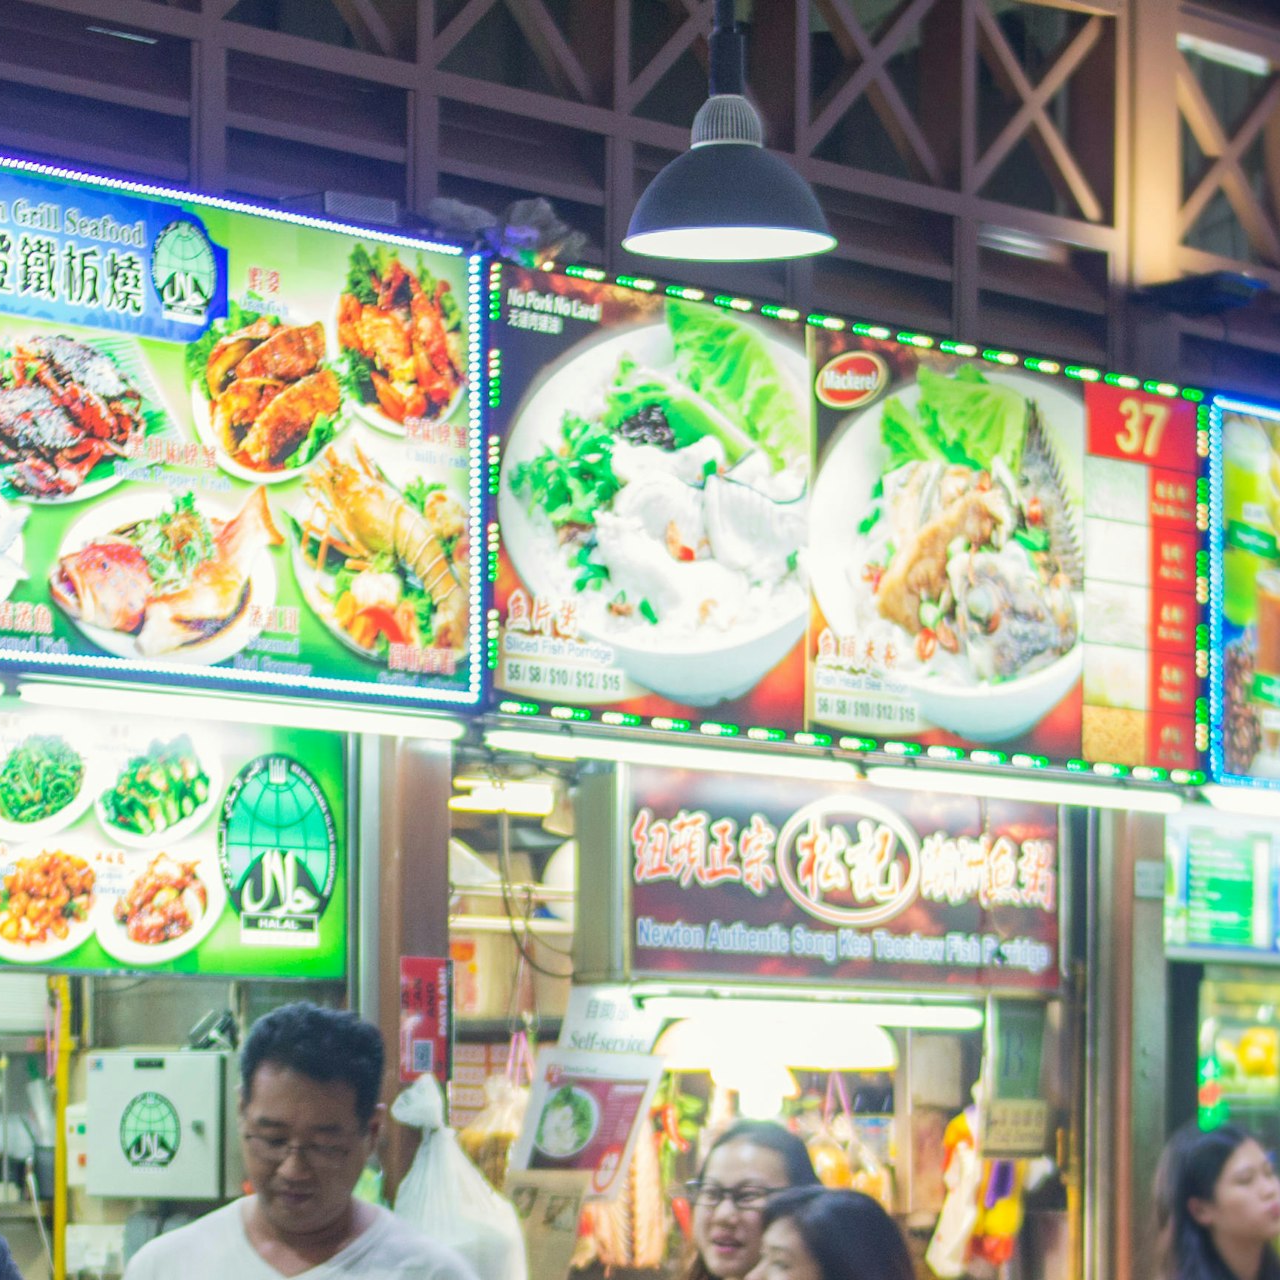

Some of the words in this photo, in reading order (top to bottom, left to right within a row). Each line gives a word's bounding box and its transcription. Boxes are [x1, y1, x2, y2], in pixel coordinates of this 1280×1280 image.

[11, 198, 63, 233] Grill
[64, 206, 148, 247] Seafood
[507, 288, 524, 308] No
[525, 291, 552, 313] Pork
[553, 297, 571, 317] No
[571, 301, 602, 322] Lard
[823, 367, 878, 392] Mackerel
[1114, 396, 1169, 458] 37
[114, 461, 152, 481] Black
[154, 466, 198, 489] Pepper
[201, 474, 232, 491] Crab
[506, 636, 539, 651] Sliced
[542, 640, 564, 655] Fish
[567, 645, 613, 664] Porridge
[508, 663, 520, 681] $5
[528, 665, 541, 683] $8
[549, 668, 568, 686] $10
[576, 671, 595, 689] $12
[602, 673, 620, 691] $15
[817, 673, 838, 684] Fish
[839, 677, 862, 688] Head
[864, 679, 882, 691] Bee
[884, 682, 909, 693] Hoon
[853, 701, 871, 718] $10
[876, 703, 893, 721] $12
[899, 706, 916, 723] $15
[258, 917, 300, 931] HALAL
[637, 917, 705, 951] Newton
[706, 919, 789, 956] Authentic
[792, 924, 836, 962] Song
[839, 928, 872, 960] Kee
[874, 930, 945, 964] Teochew
[946, 935, 981, 966] Fish
[982, 937, 1053, 974] Prridge
[438, 966, 447, 1037] PAYLAH!
[570, 1031, 646, 1051] Self-service
